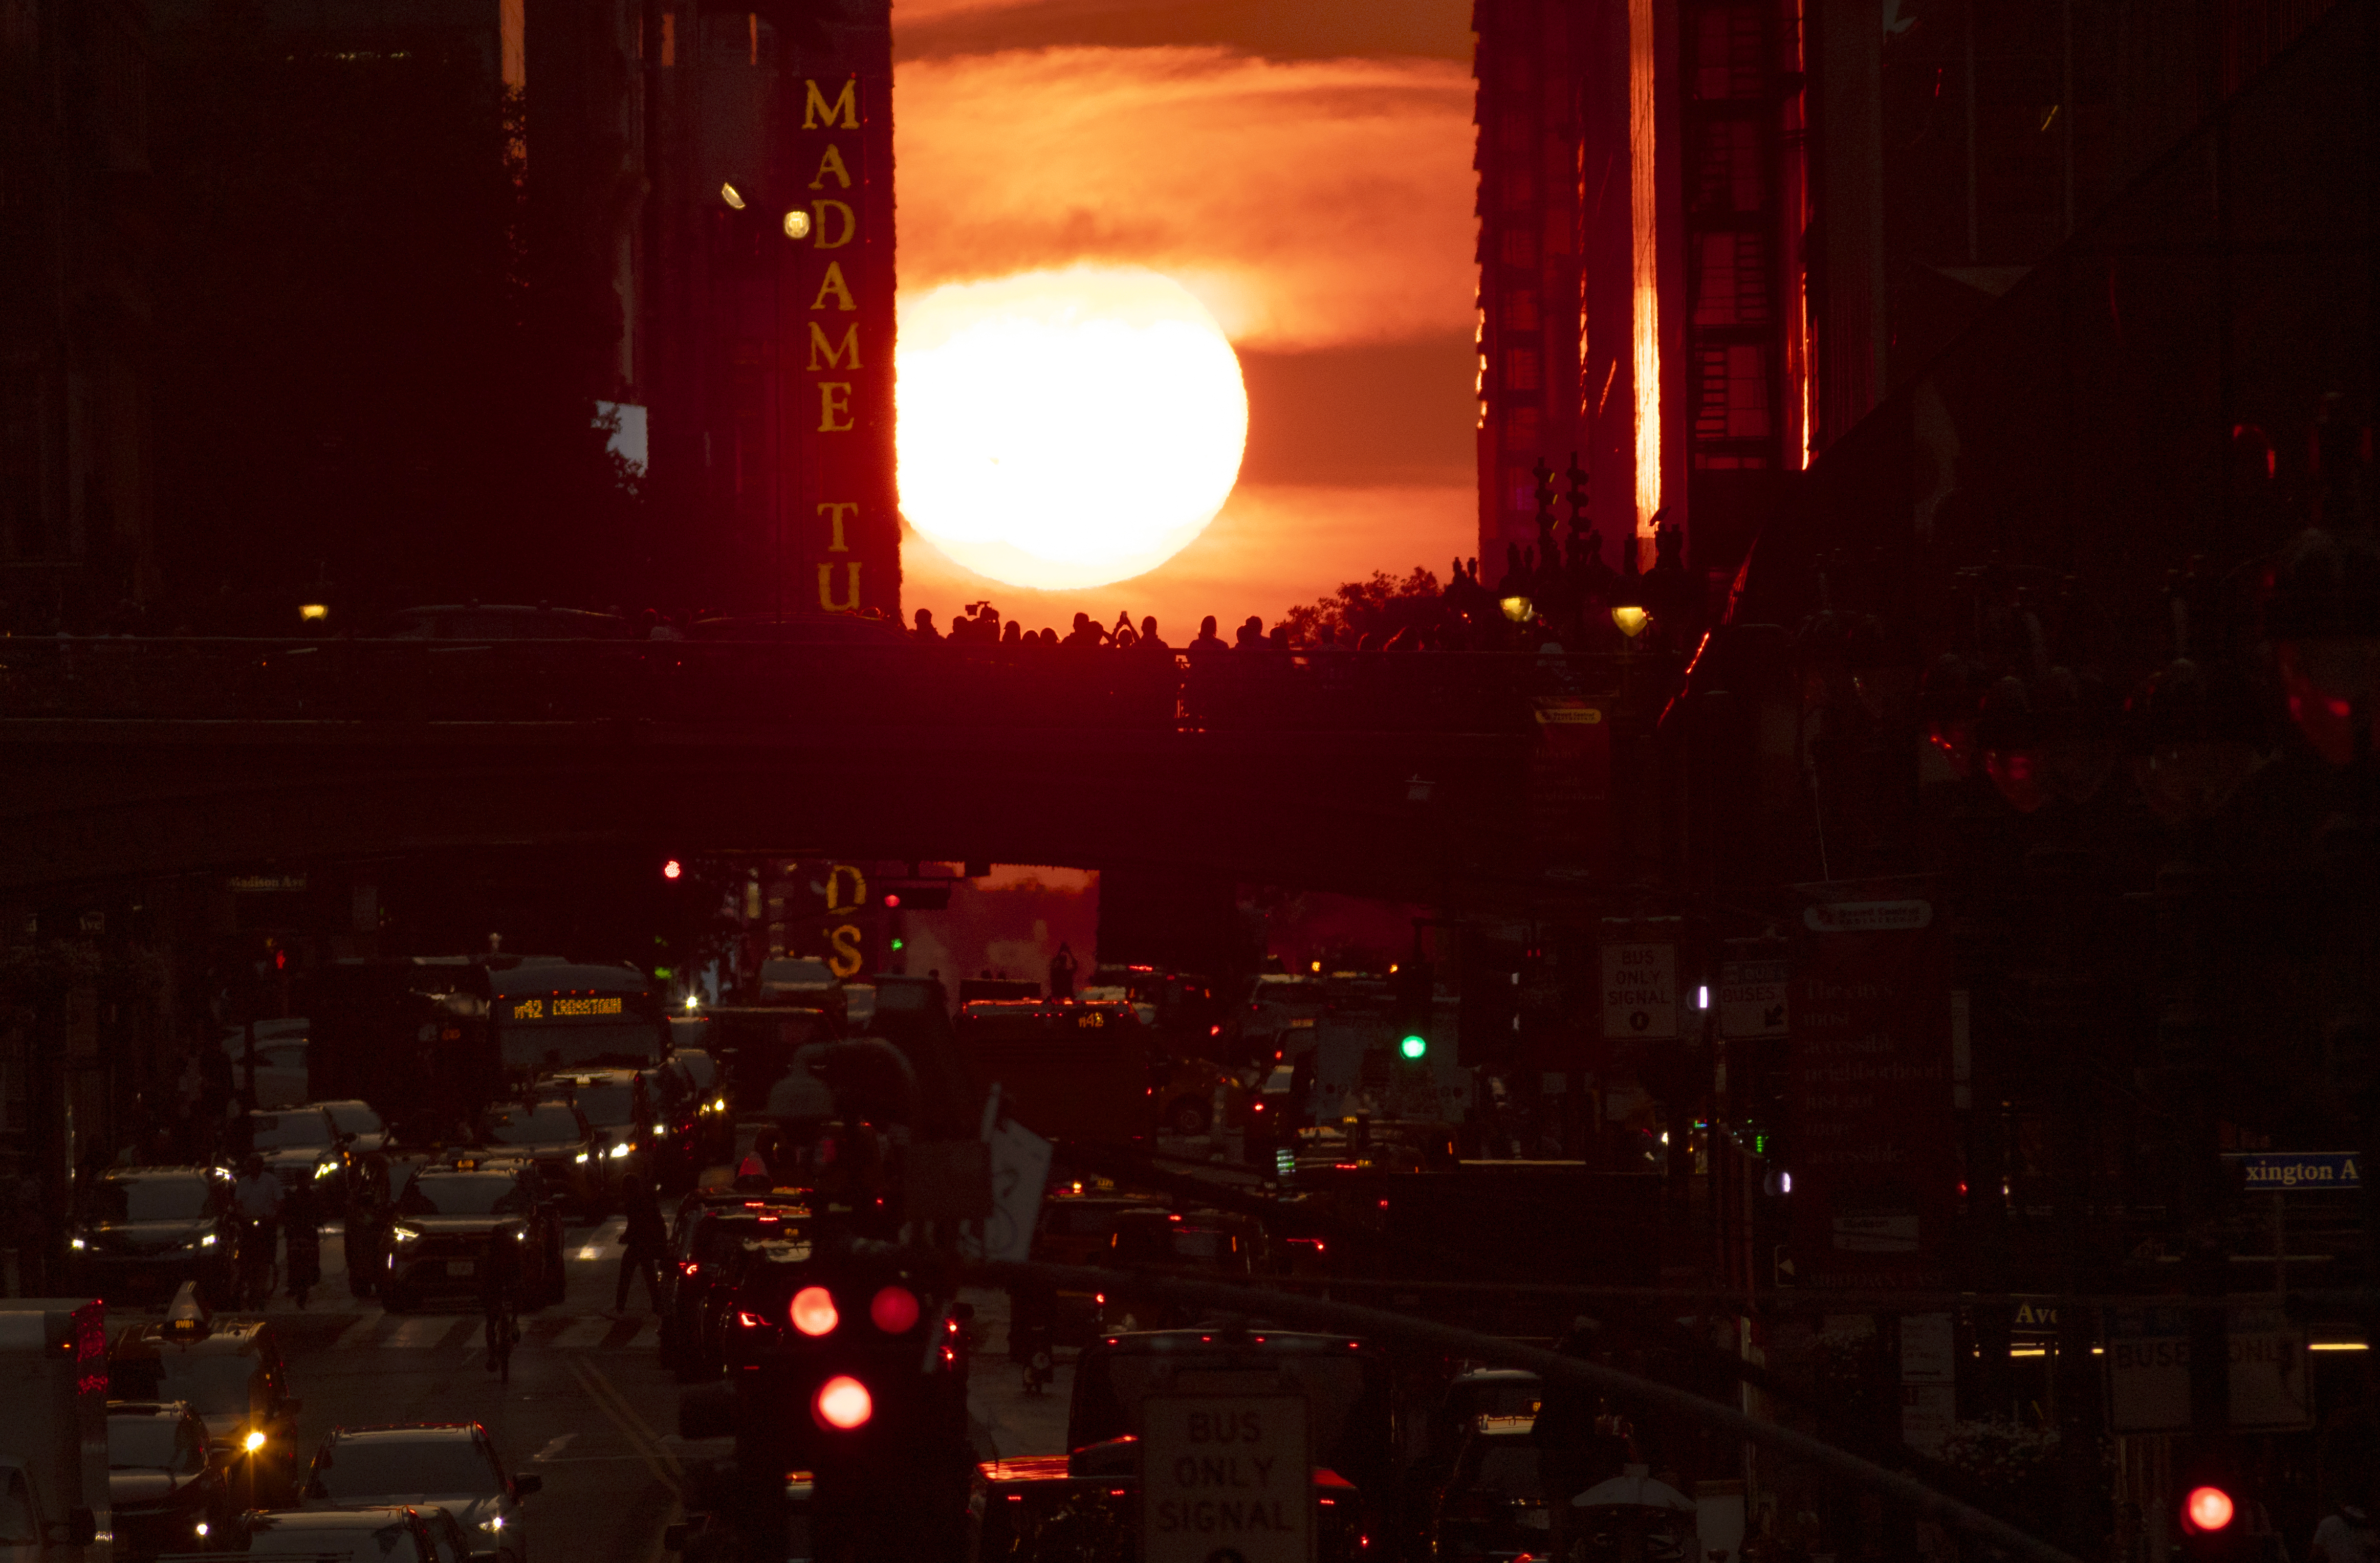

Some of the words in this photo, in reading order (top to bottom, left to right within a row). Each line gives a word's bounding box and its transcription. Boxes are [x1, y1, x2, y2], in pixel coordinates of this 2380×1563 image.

[802, 79, 864, 432] MADAME
[1622, 950, 1654, 965] BUS
[1615, 970, 1662, 986] ONLY
[1608, 990, 1671, 1006] SIGNAL
[1721, 985, 1775, 1003] BUSES
[552, 998, 622, 1016] CROSSTOWN
[1188, 1411, 1261, 1444] BUS
[1174, 1455, 1276, 1488] ONLY
[1156, 1499, 1295, 1533] SIGNAL
